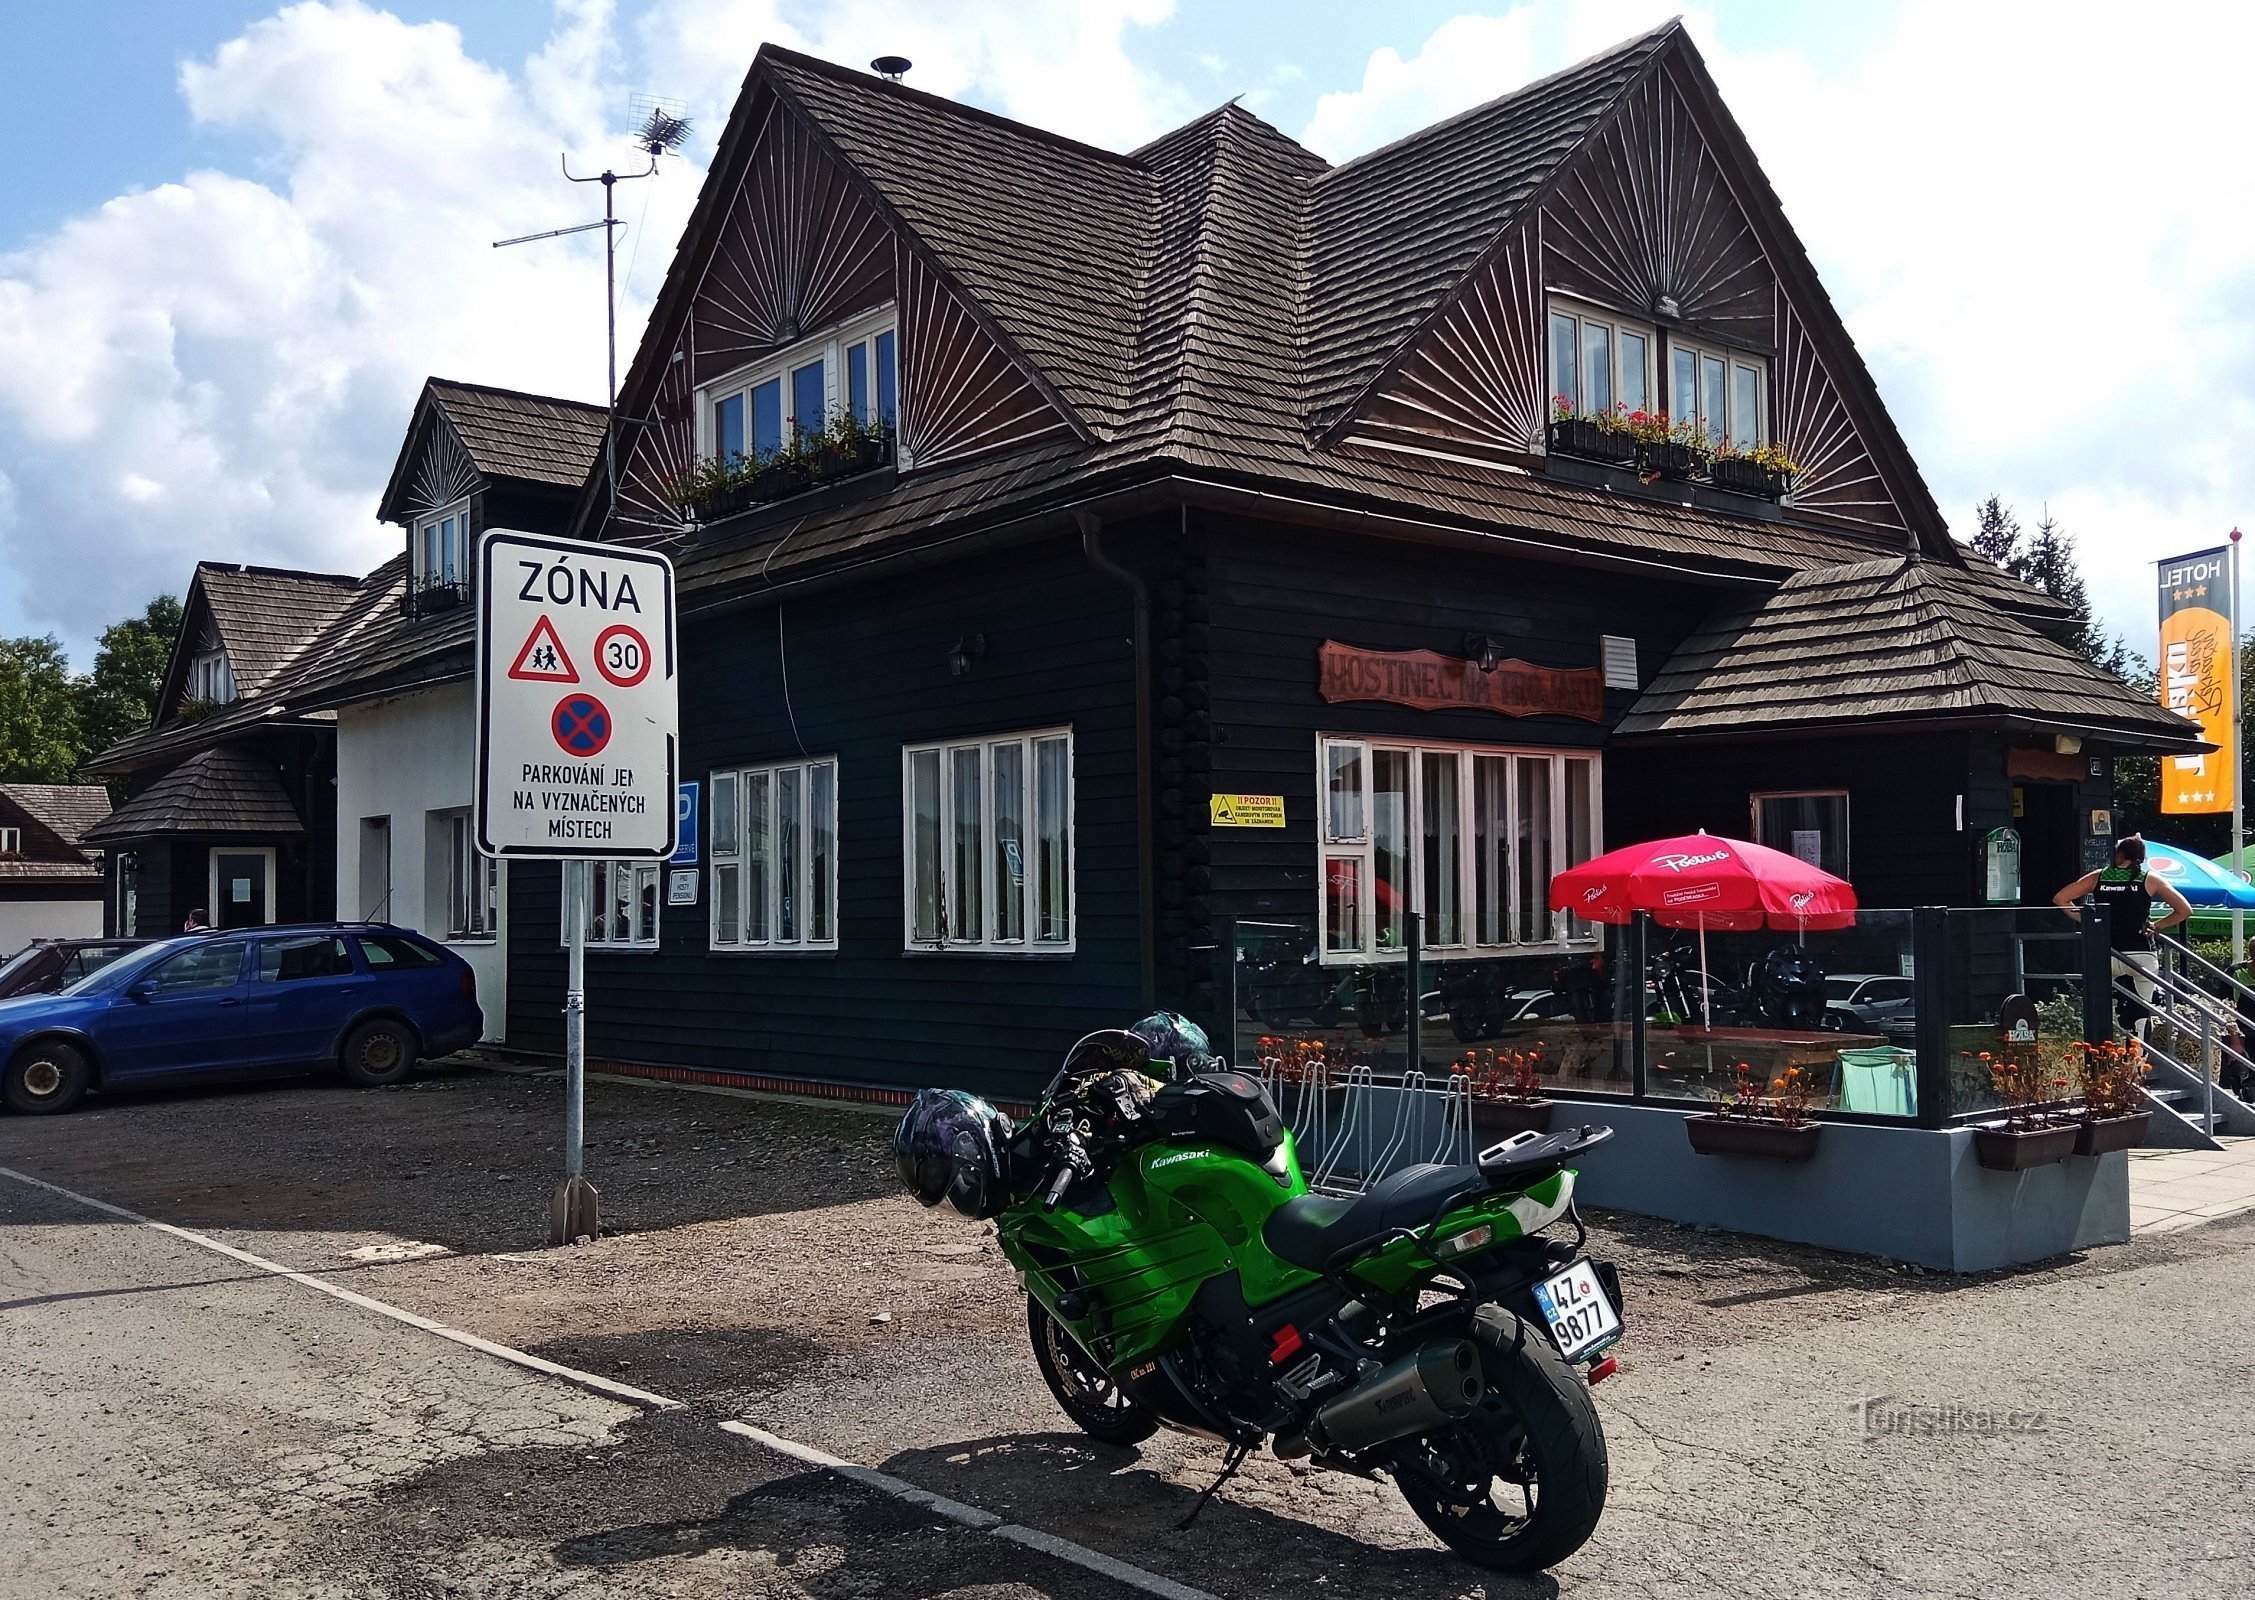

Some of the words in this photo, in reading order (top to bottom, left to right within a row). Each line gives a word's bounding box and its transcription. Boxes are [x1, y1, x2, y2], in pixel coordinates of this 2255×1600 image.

[519, 555, 642, 613] ZÓNA
[608, 642, 639, 670] 30
[522, 762, 605, 786] PARKOVÁNÍ
[513, 791, 535, 809] NA
[542, 789, 646, 813] VYZNAČENÝCH
[1244, 797, 1271, 805] POZOR
[548, 815, 612, 839] MÍSTECH
[1151, 1149, 1210, 1170] Kawasaki
[1553, 1276, 1581, 1309] 4Z
[1546, 1307, 1558, 1319] CZ
[1555, 1300, 1603, 1348] 9877
